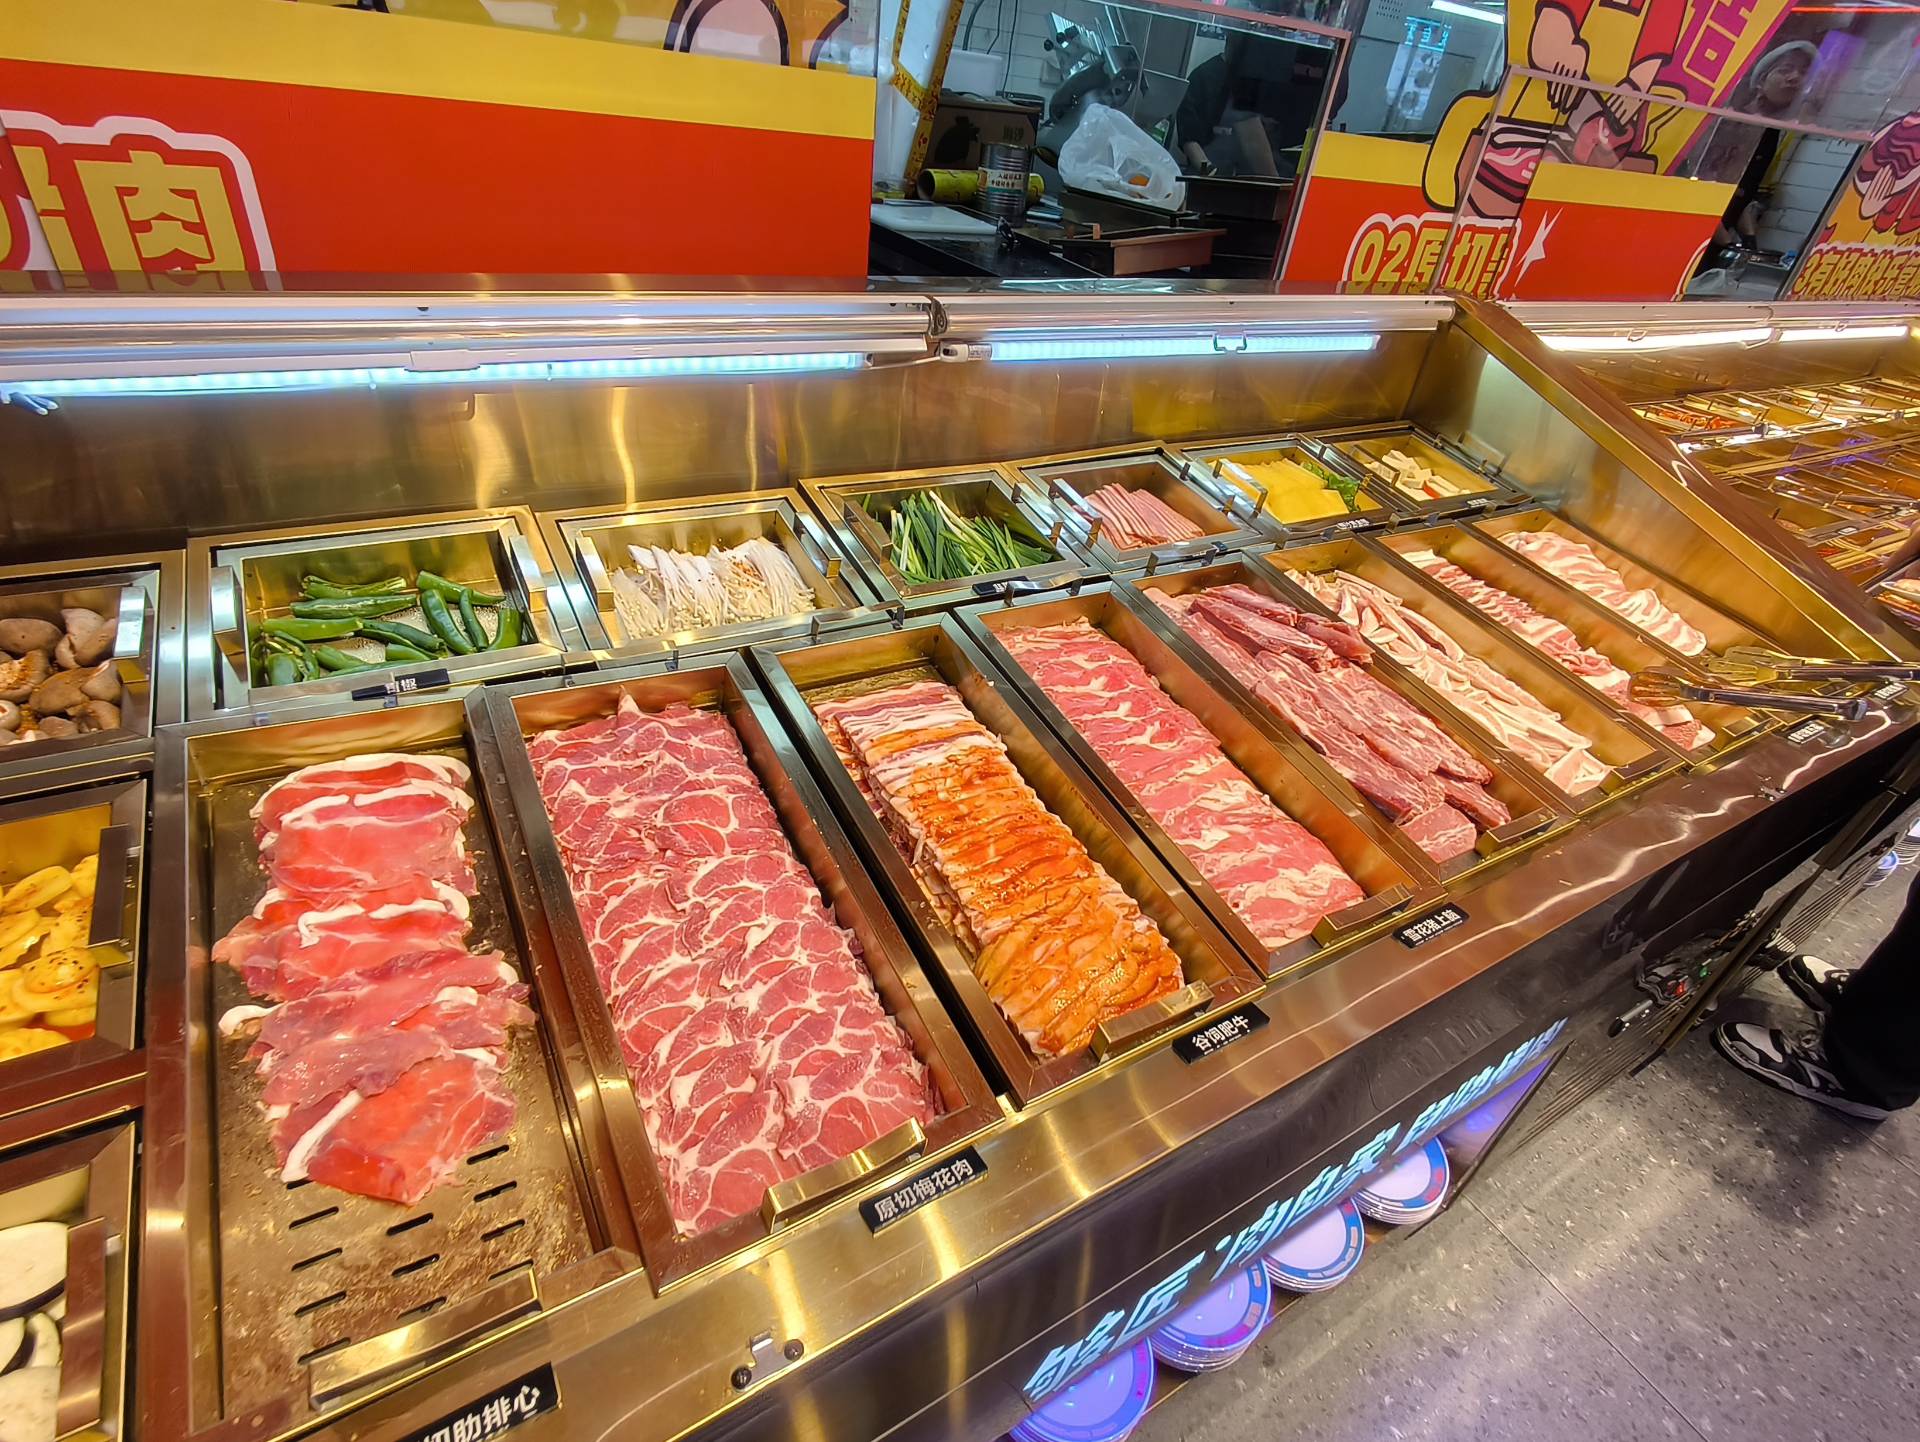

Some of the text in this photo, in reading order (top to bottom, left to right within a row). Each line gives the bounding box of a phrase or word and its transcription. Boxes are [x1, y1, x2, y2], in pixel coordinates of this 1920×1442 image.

[1192, 1015, 1249, 1051] 谷饲肥牛
[874, 1158, 974, 1222] 原切梅花肉
